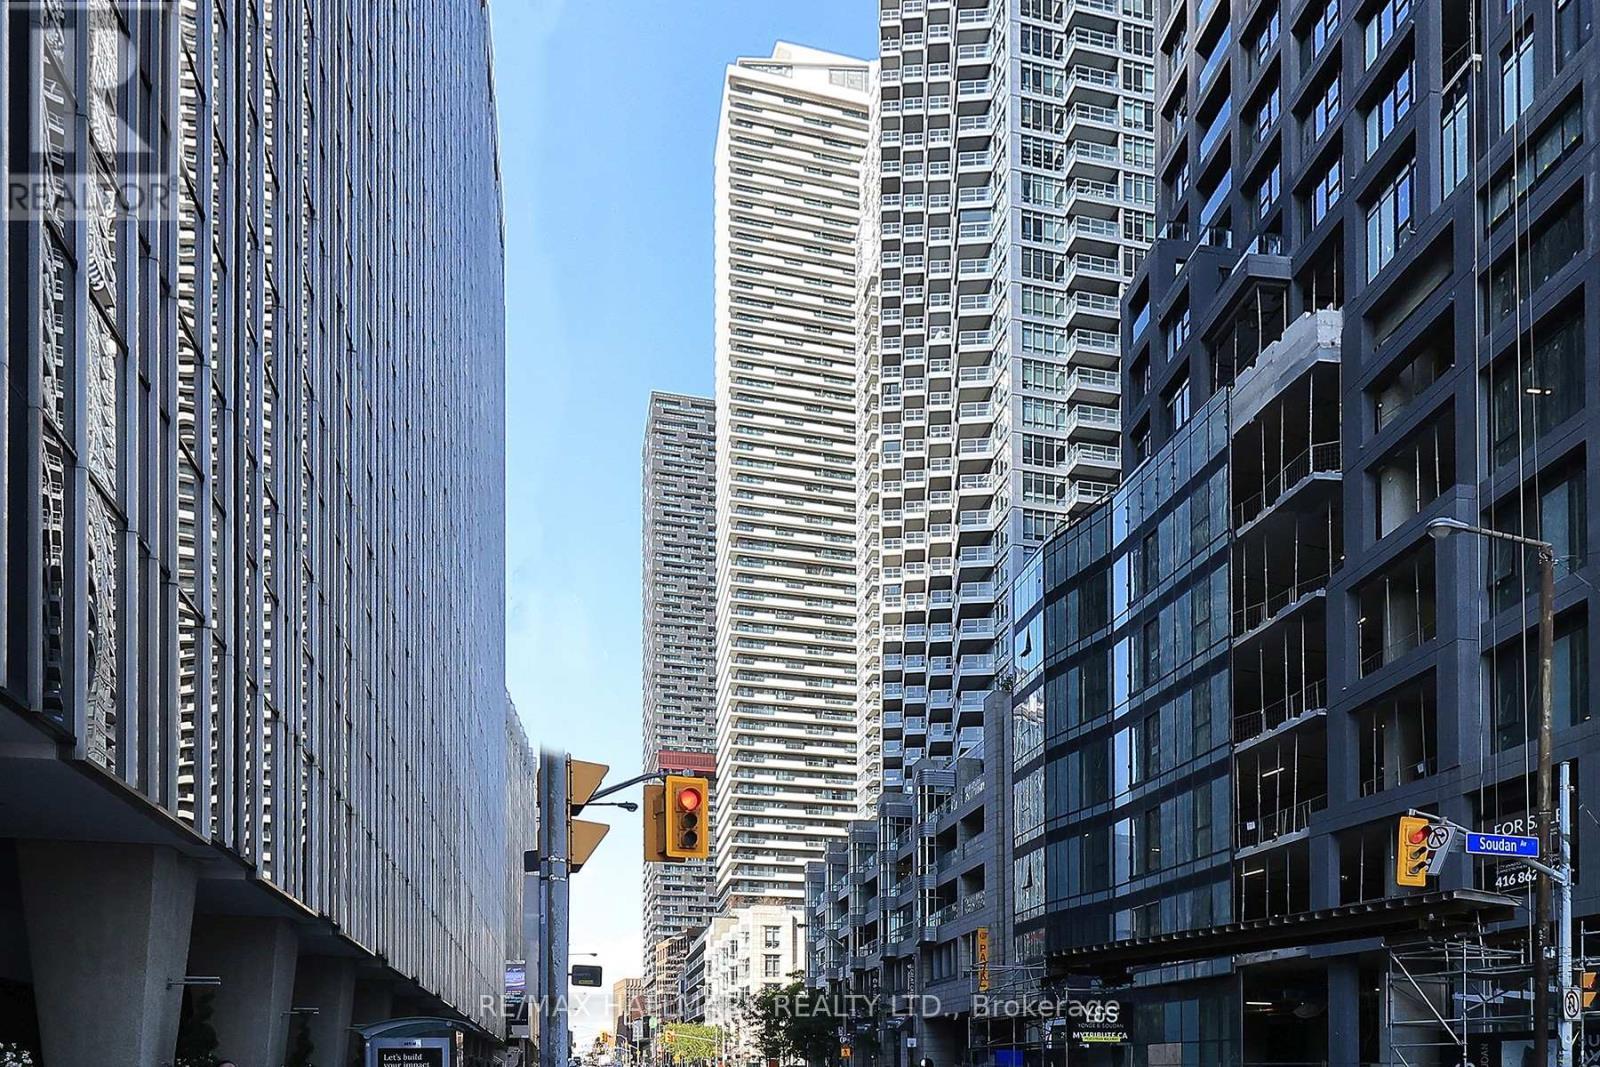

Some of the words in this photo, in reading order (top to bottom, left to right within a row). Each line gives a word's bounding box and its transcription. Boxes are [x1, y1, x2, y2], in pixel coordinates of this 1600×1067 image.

[1494, 818, 1524, 836] FOR
[1528, 808, 1560, 830] SE
[1479, 837, 1517, 853] Soudan
[1495, 872, 1516, 888] 416
[1518, 868, 1537, 883] 862
[1072, 1031, 1128, 1040] MYTRIBUTECA
[383, 1053, 401, 1061] Let's
[403, 1053, 423, 1061] build
